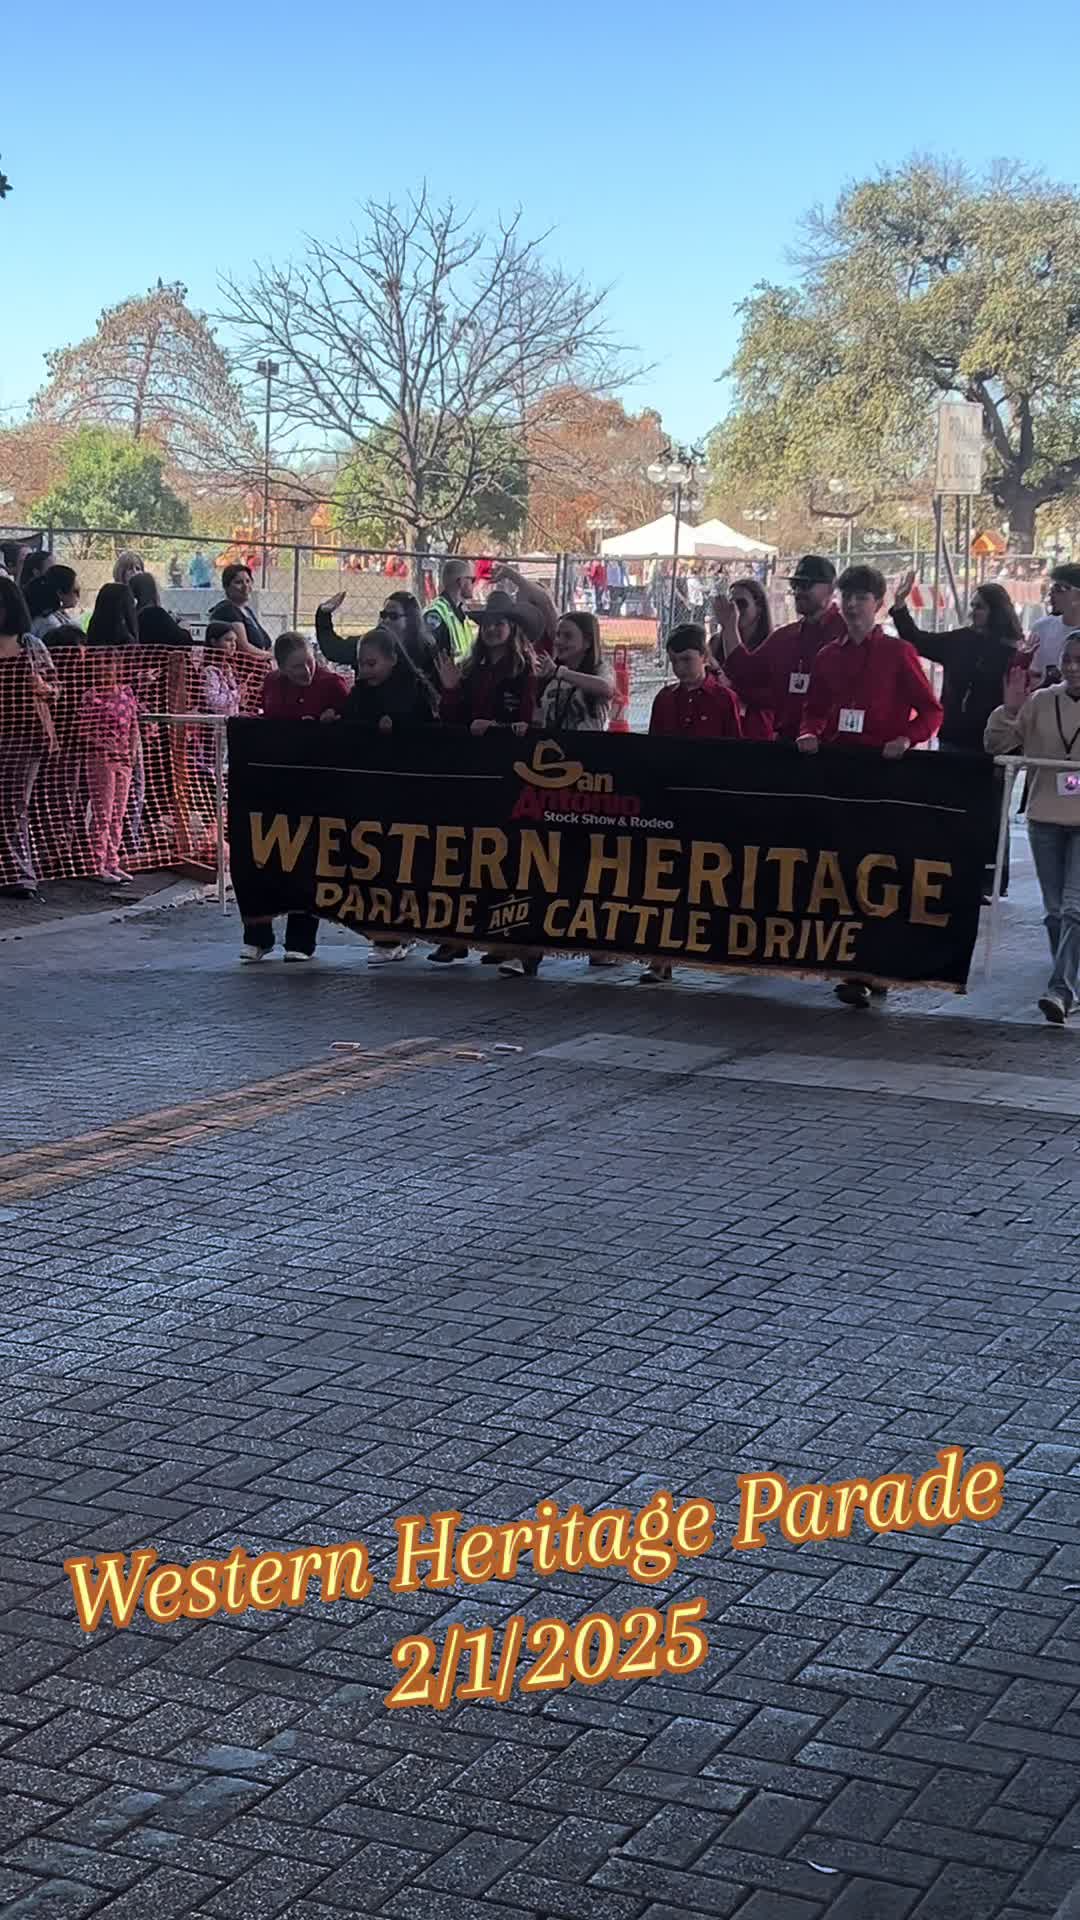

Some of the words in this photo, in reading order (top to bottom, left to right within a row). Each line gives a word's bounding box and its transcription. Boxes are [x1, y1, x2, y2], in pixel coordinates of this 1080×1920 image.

[512, 738, 614, 793] San
[543, 810, 579, 825] Stock
[581, 813, 615, 827] Show
[617, 816, 628, 827] &
[630, 816, 674, 830] Rodeo
[249, 811, 562, 895] WESTERN
[583, 833, 953, 928] HERITAGE
[315, 882, 479, 934] PARADE
[488, 900, 530, 931] AND
[543, 899, 713, 952] CATTLE
[727, 914, 863, 962] DRIVE
